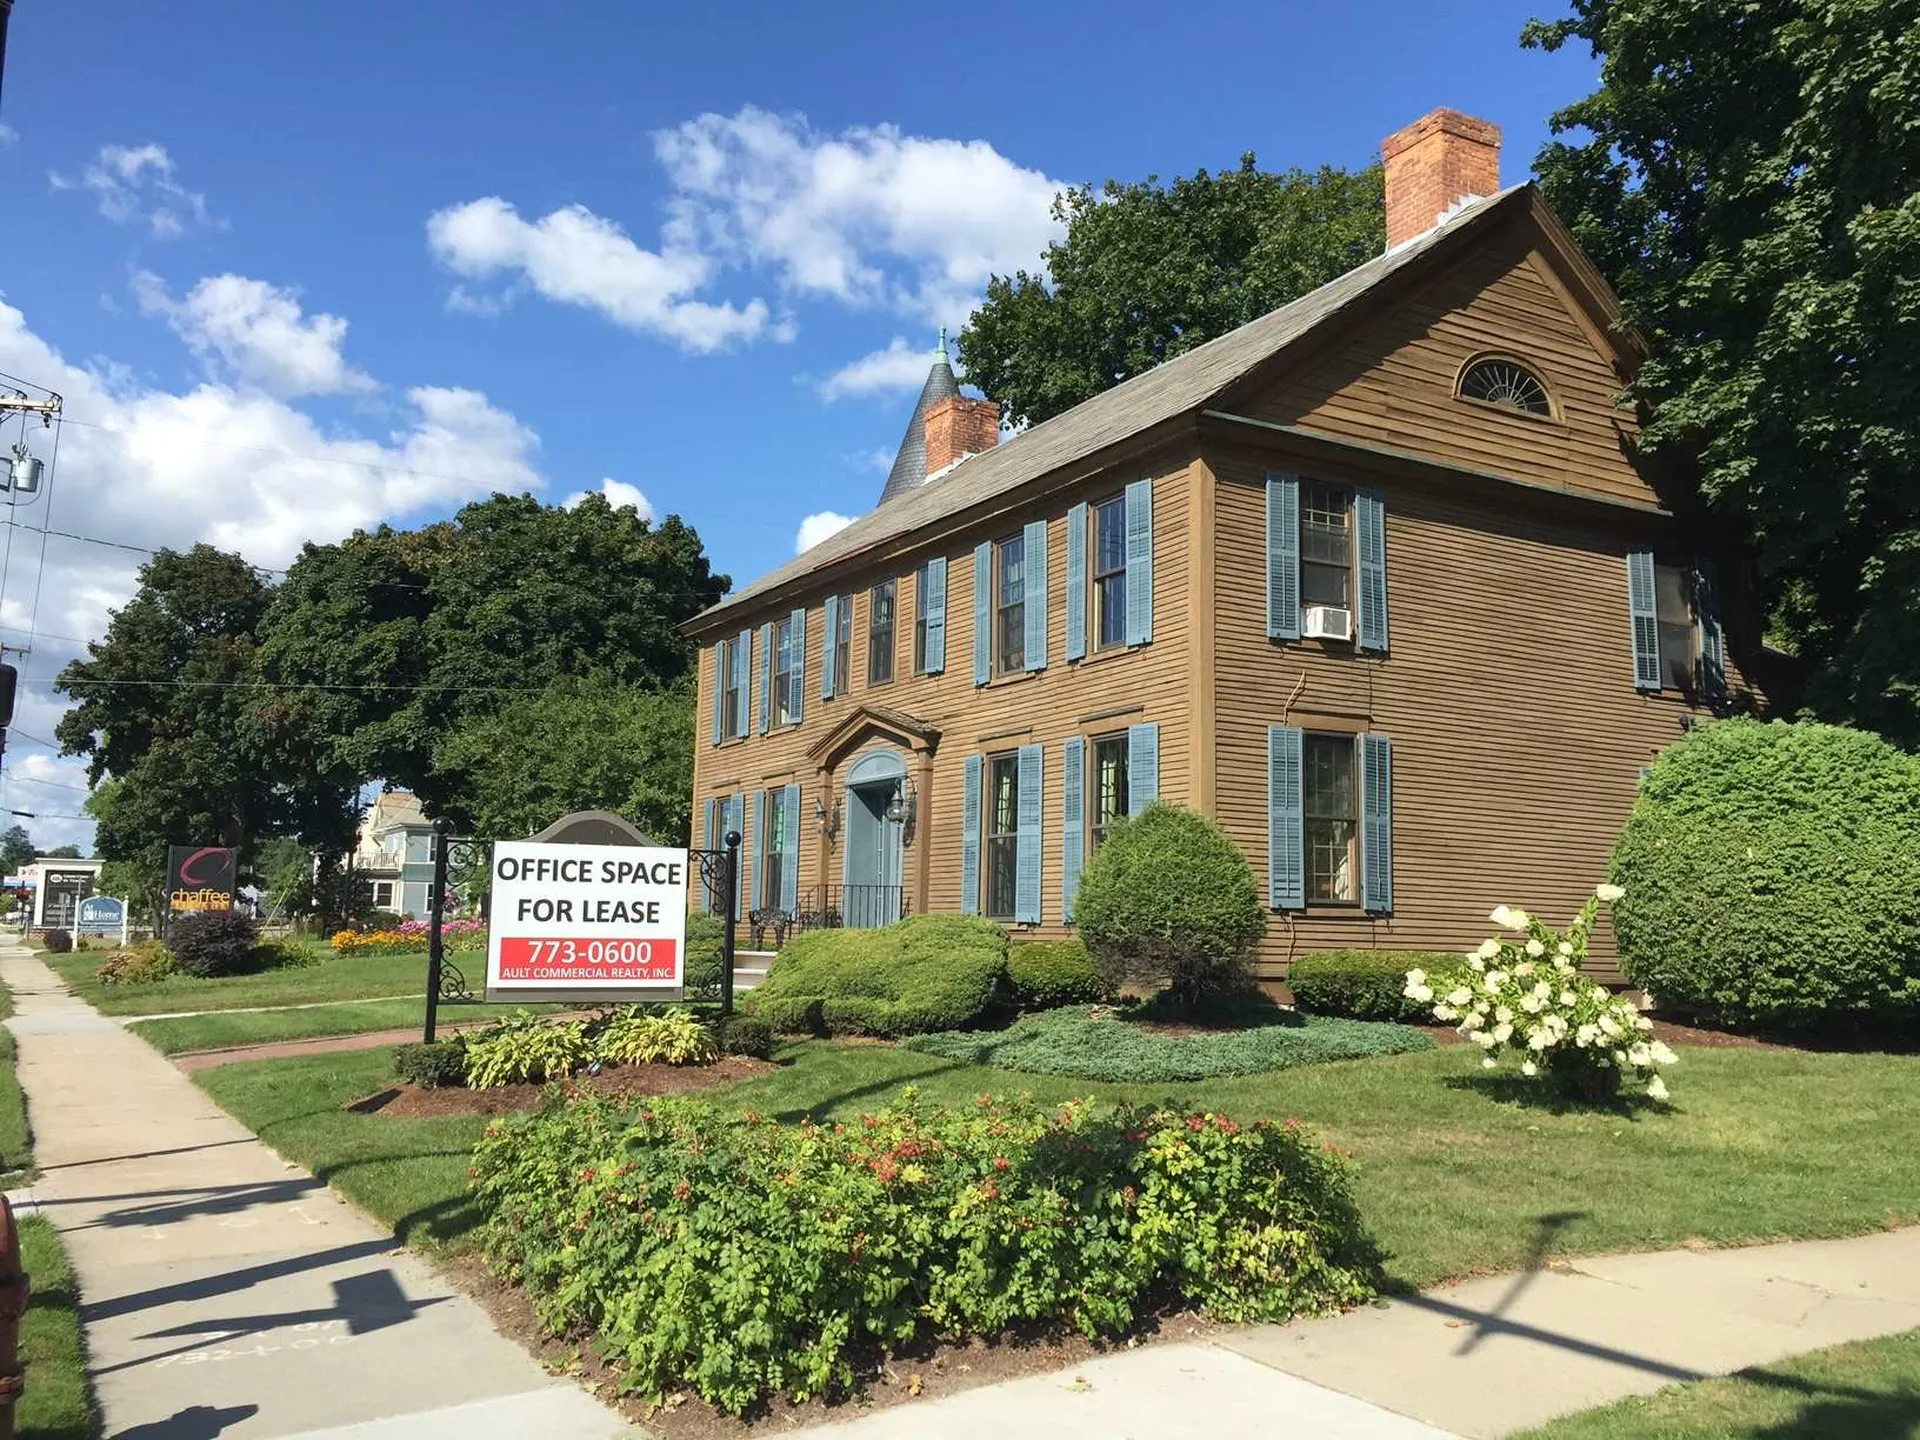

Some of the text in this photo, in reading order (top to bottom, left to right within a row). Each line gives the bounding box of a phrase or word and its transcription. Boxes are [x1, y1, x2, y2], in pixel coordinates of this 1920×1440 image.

[497, 857, 682, 885] OFFICE SPACE
[170, 888, 231, 904] chaffee
[94, 909, 120, 920] Home
[517, 898, 660, 924] FOR LEASE
[527, 940, 653, 964] 773-0600
[502, 967, 674, 979] AULT COMMERCIAL REALTY, INC.
